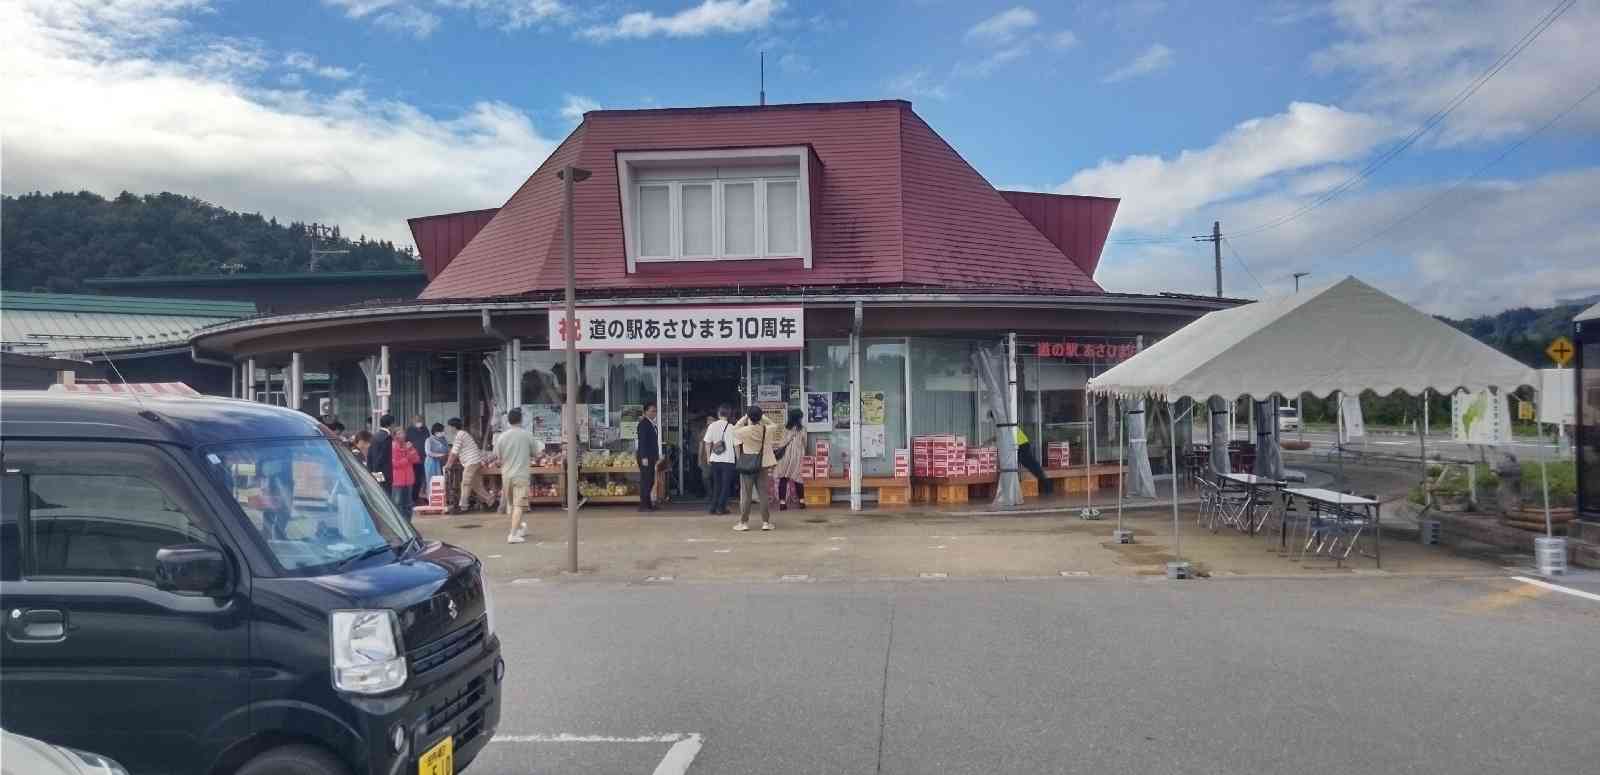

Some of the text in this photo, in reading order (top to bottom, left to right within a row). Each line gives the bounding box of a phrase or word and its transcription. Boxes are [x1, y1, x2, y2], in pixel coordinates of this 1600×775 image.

[589, 317, 797, 340] 道の駅あさひまち10周年
